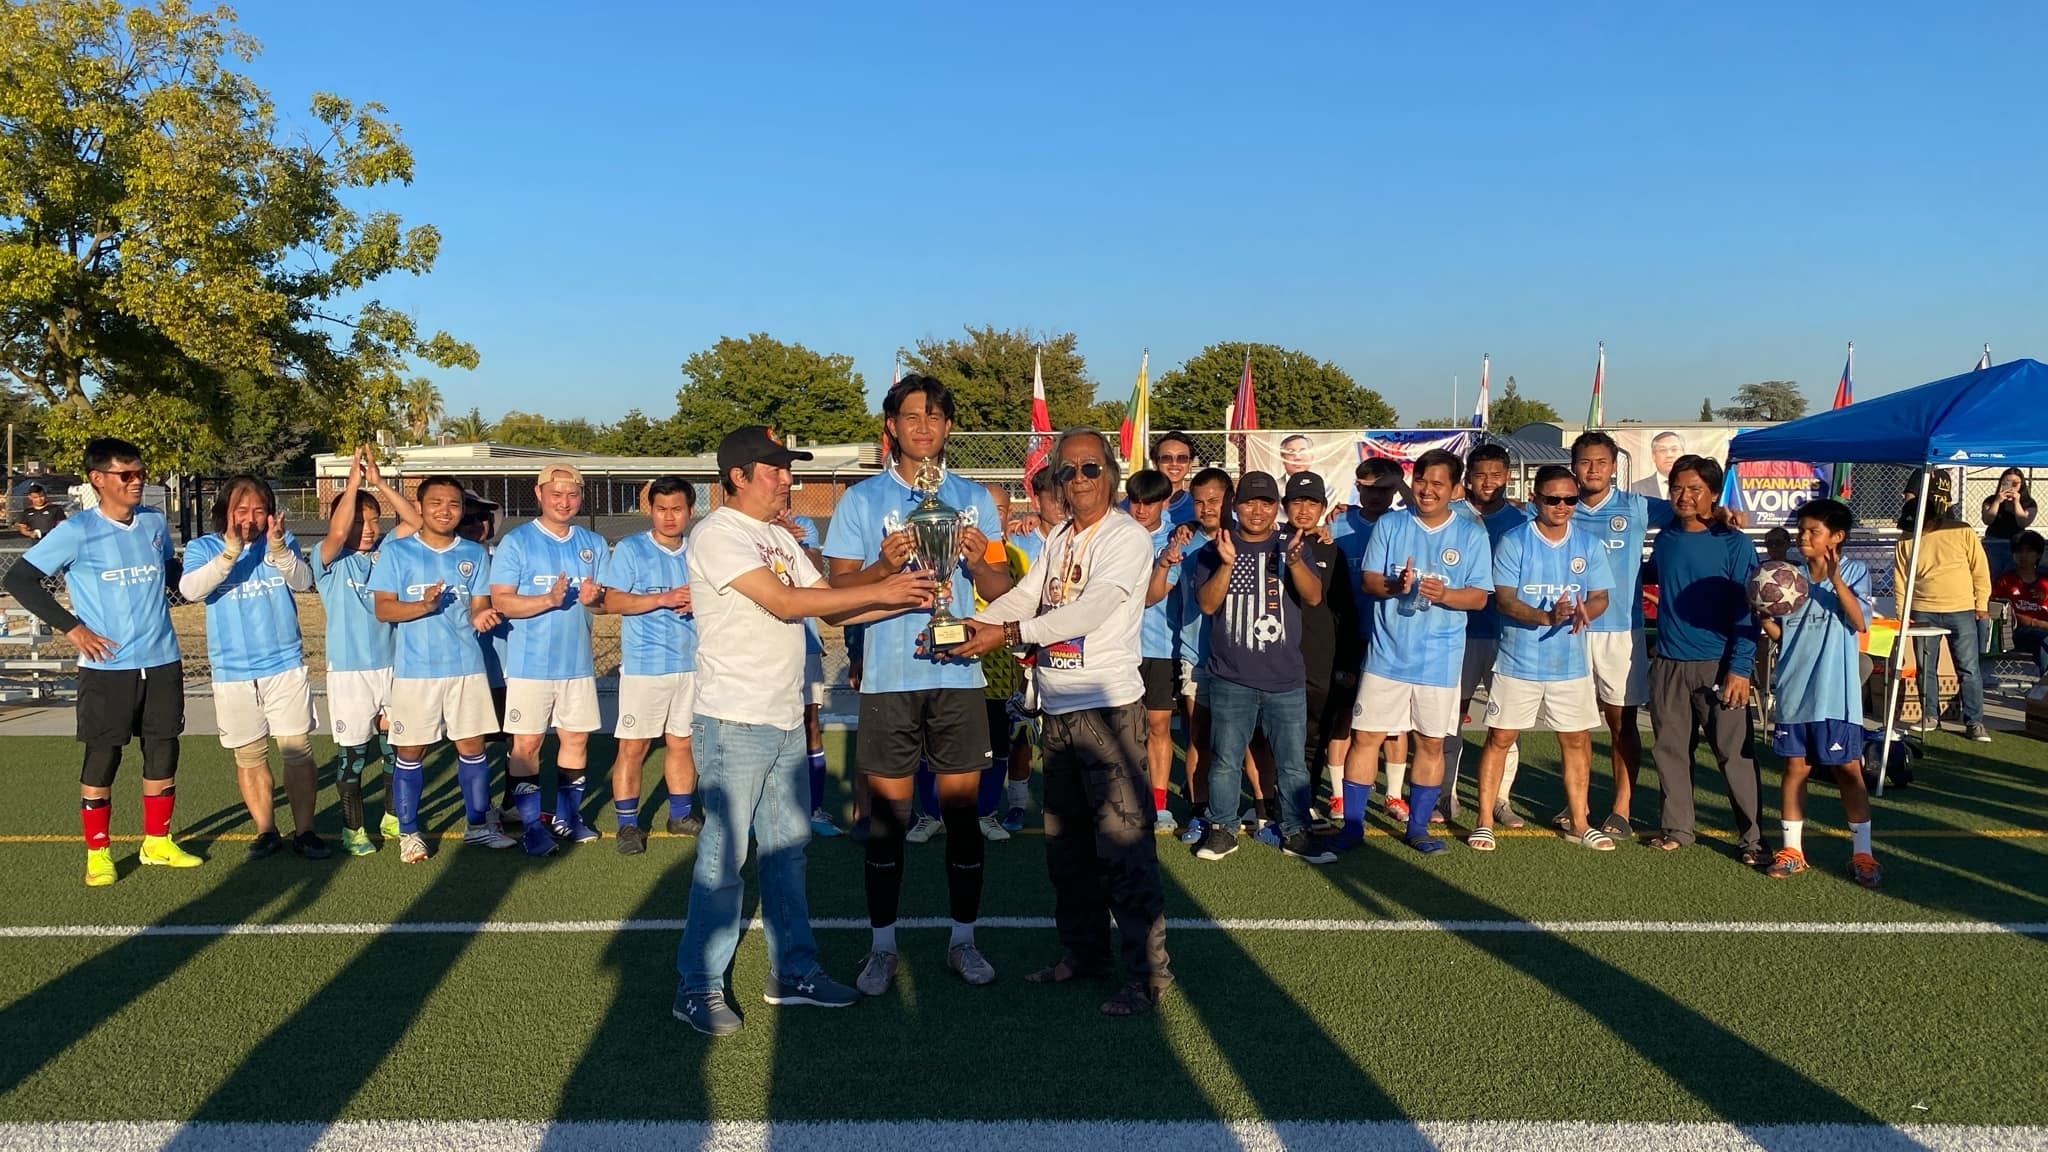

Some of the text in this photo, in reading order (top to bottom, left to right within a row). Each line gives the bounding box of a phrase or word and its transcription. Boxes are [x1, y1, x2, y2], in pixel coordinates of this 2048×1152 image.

[1742, 478, 1820, 490] MYANMAR'S
[101, 564, 158, 582] ETIHA
[1522, 583, 1581, 595] ETIHAD
[1049, 657, 1083, 669] VOICE
